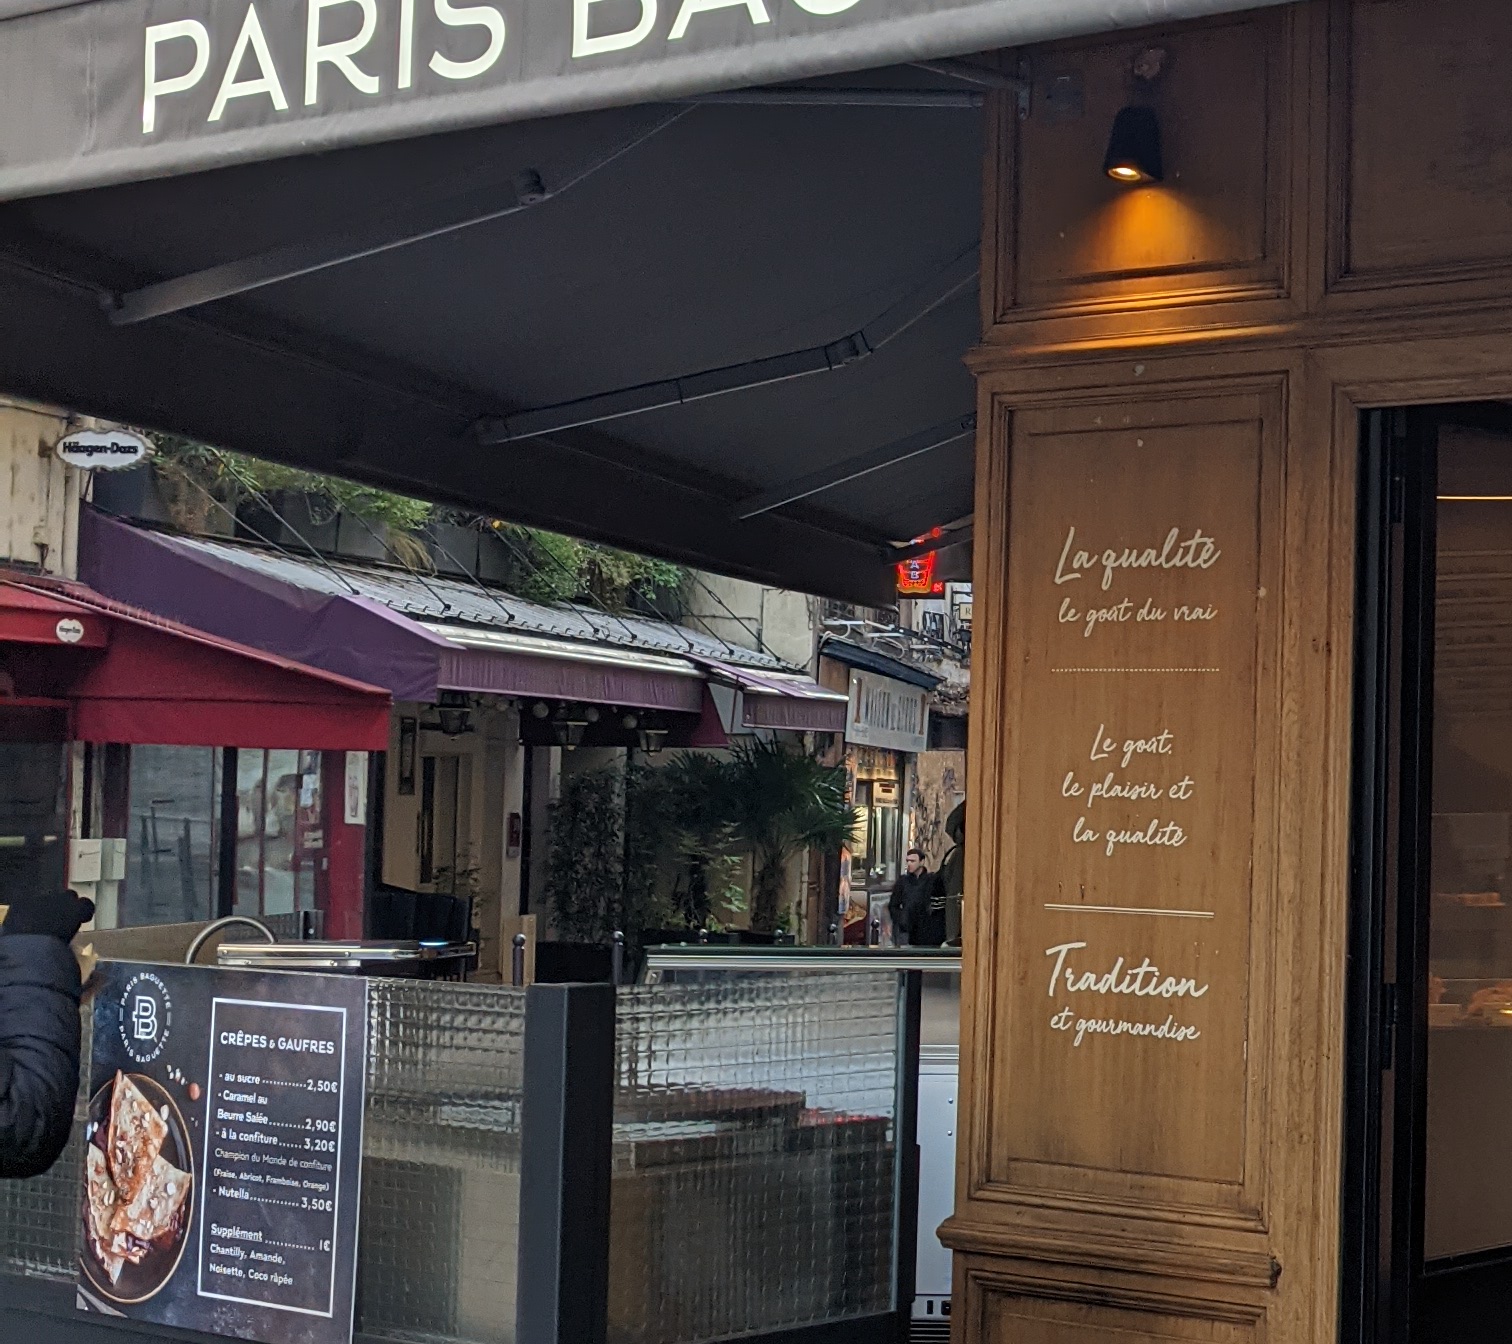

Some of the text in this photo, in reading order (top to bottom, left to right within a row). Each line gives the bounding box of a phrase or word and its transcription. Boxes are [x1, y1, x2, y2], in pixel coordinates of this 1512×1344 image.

[1054, 526, 1222, 590] La qualité
[1058, 597, 1081, 623] le
[1136, 597, 1167, 622] du
[1173, 604, 1218, 622] vrai
[1090, 723, 1117, 761] Le
[1062, 771, 1195, 808] le plaisir et
[1073, 816, 1188, 856] la qualité
[1045, 941, 1209, 998] Tradition
[120, 972, 172, 1009] PARIS BAGUETTE
[1050, 1006, 1201, 1047] et gourmandise
[220, 1030, 267, 1048] CRÊPES
[277, 1037, 335, 1054] GAUFRES
[224, 1073, 235, 1082] au
[237, 1074, 261, 1084] sucre
[222, 1090, 268, 1105] Caramel au
[217, 1108, 244, 1121] Beurre
[239, 1131, 278, 1145] confiture
[218, 1186, 249, 1199] Nutella
[211, 1223, 263, 1242] Supplément
[248, 1268, 269, 1281] Coco
